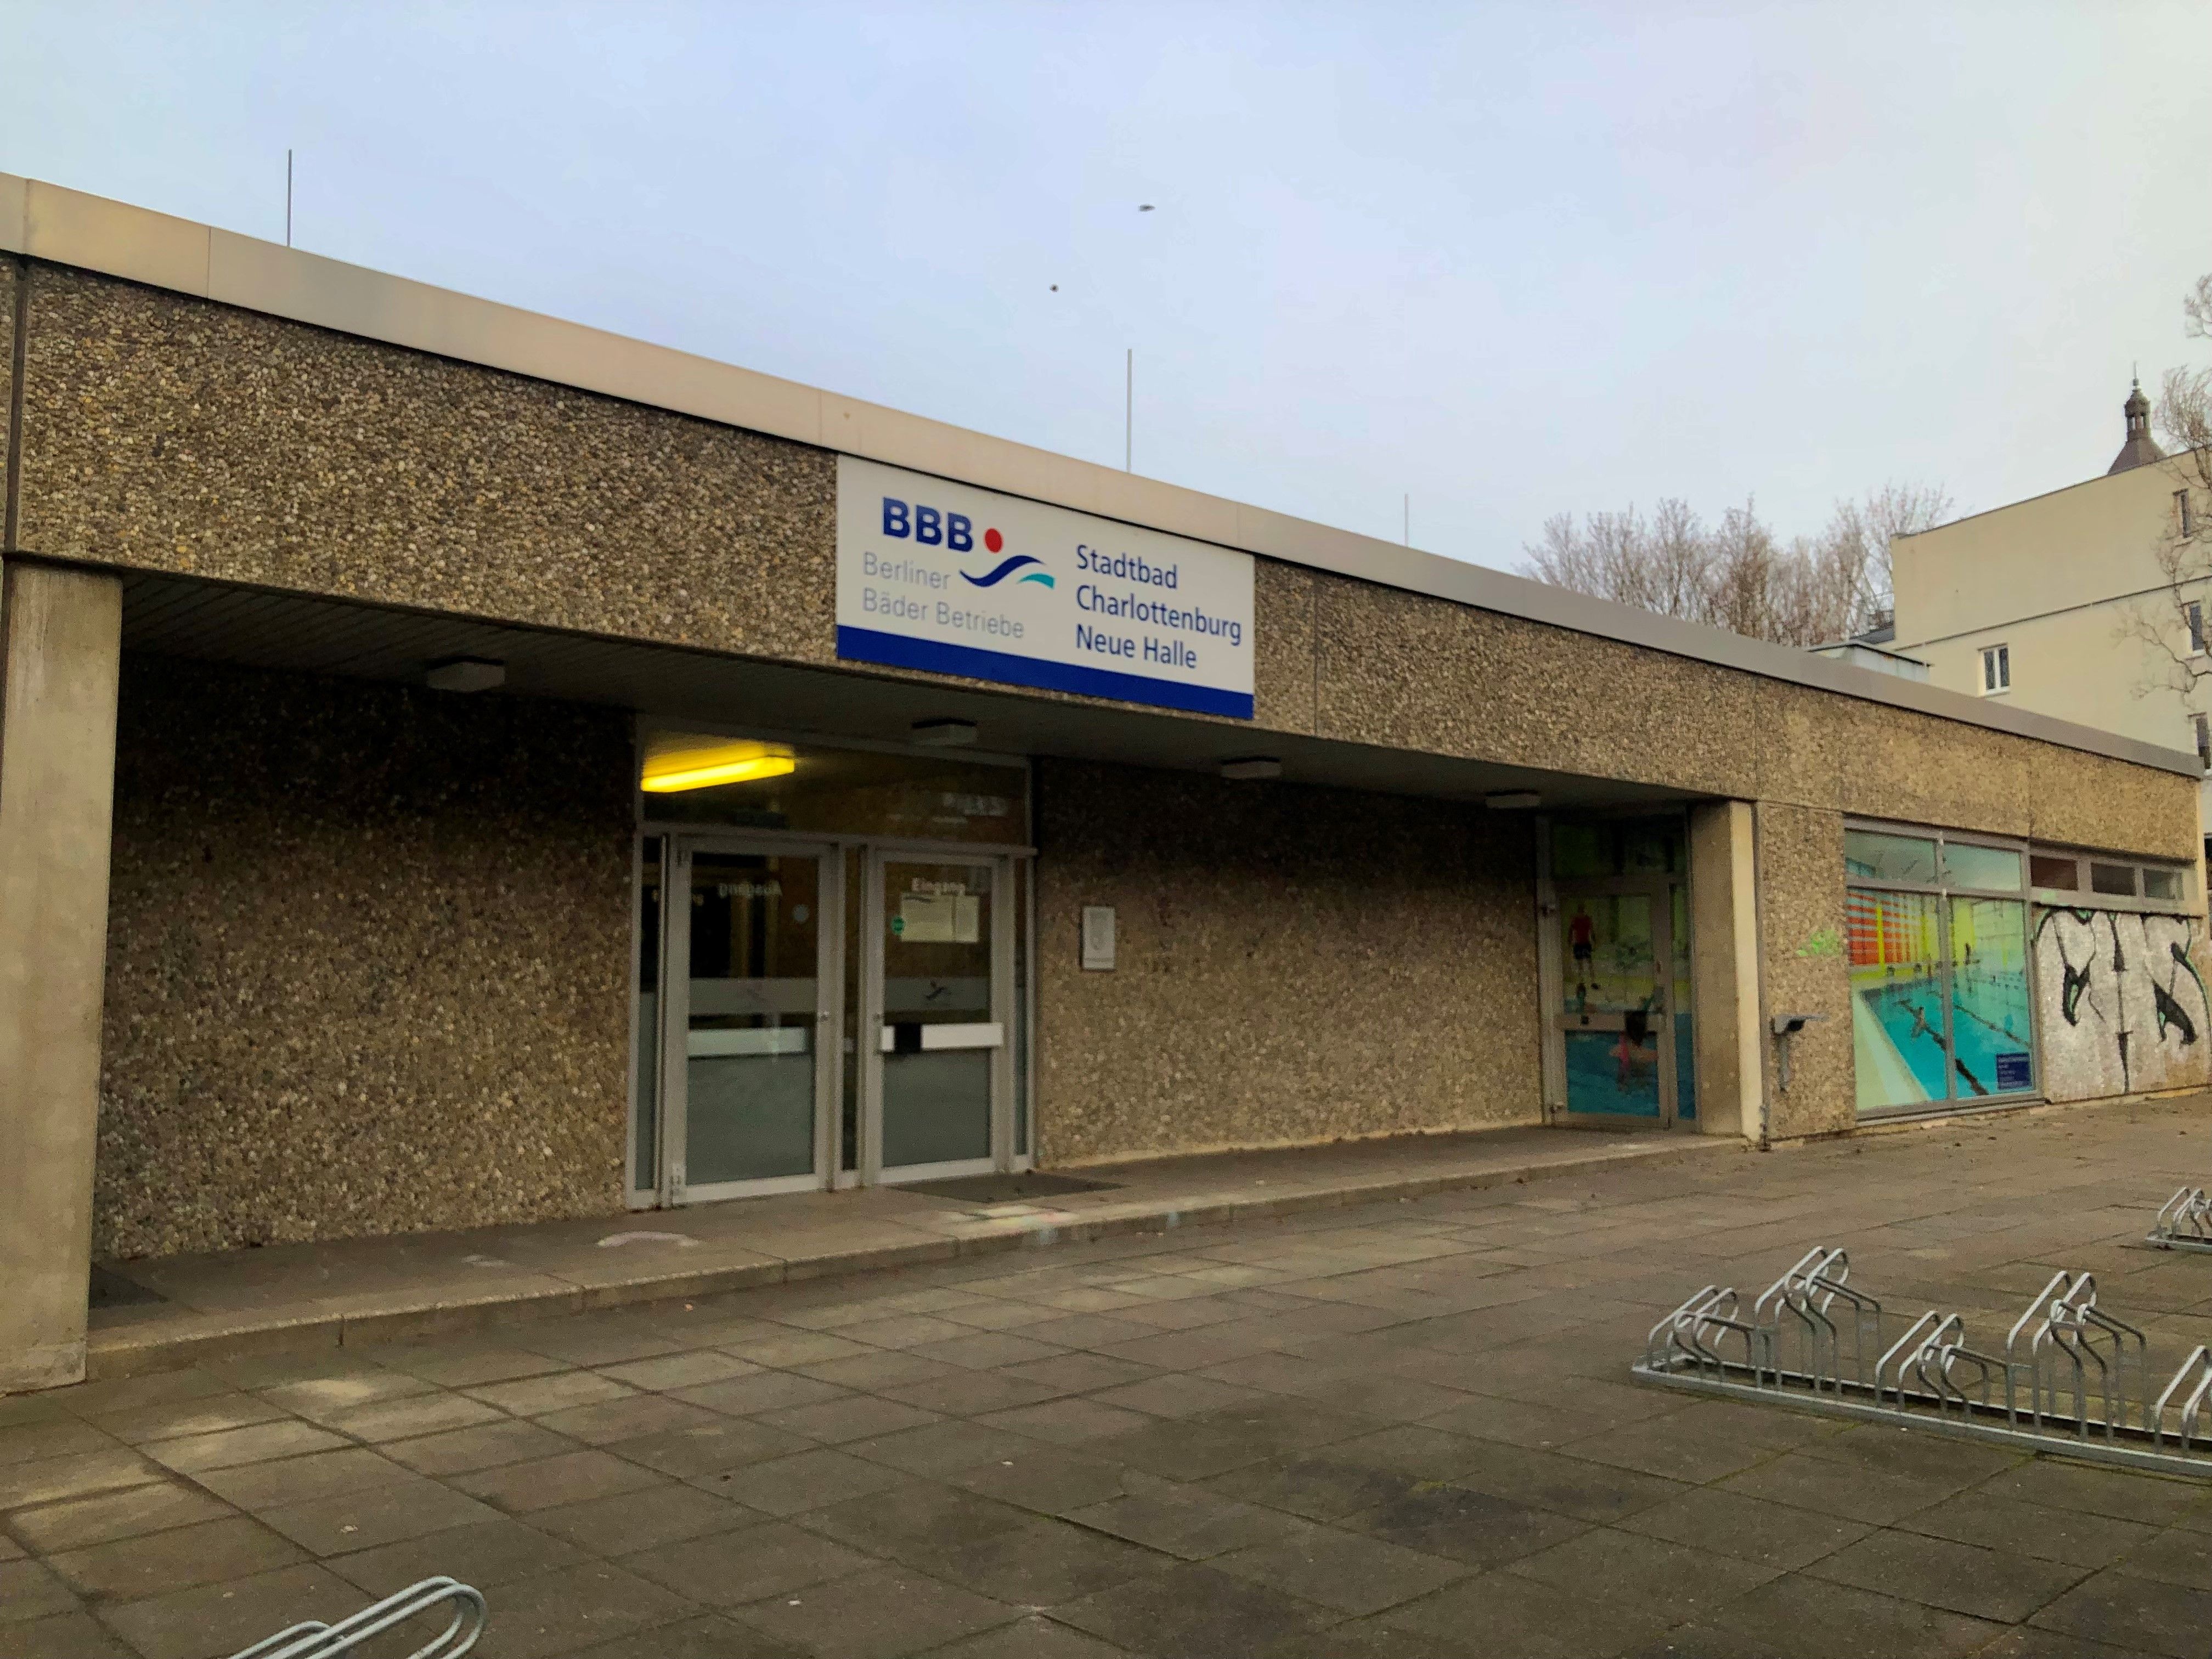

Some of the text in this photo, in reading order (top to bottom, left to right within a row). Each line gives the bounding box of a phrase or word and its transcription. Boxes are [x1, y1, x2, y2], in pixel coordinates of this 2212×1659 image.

[882, 496, 973, 553] BBB
[862, 550, 952, 590] Berliner
[1077, 544, 1177, 589] Stadtbad
[862, 587, 1024, 639] Bäder Betriebe
[1077, 584, 1242, 647] Charlottenburg
[1077, 623, 1197, 669] Neue Halle
